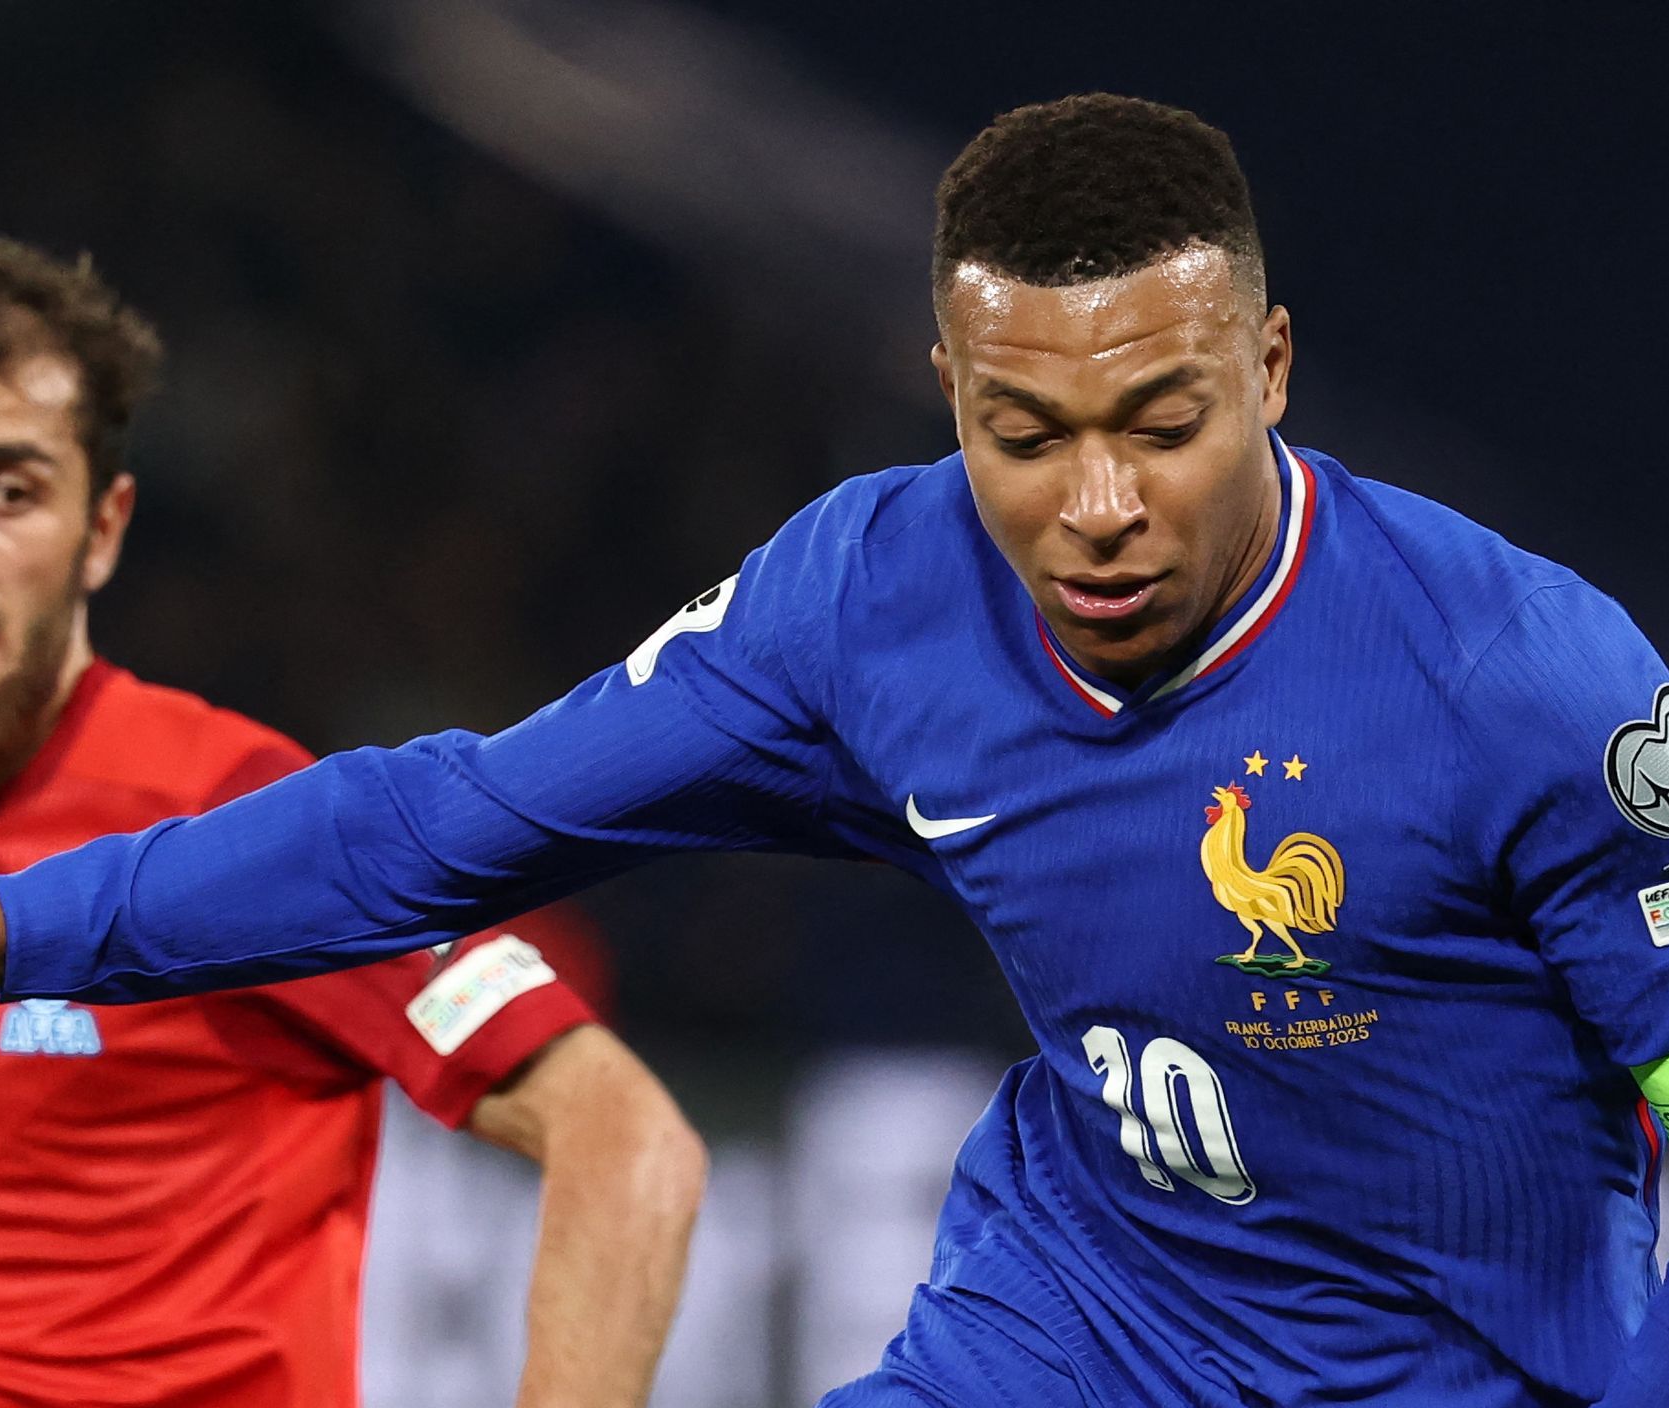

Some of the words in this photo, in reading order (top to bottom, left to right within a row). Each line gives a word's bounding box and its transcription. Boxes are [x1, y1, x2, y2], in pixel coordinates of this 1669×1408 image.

[1225, 1020, 1274, 1036] FRANCE
[1287, 1008, 1379, 1036] AZERBAÏDJAN
[1243, 1036, 1260, 1049] 10
[1263, 1034, 1324, 1050] OCTOBRE
[1326, 1025, 1369, 1047] 2025
[1081, 1025, 1257, 1206] 10
